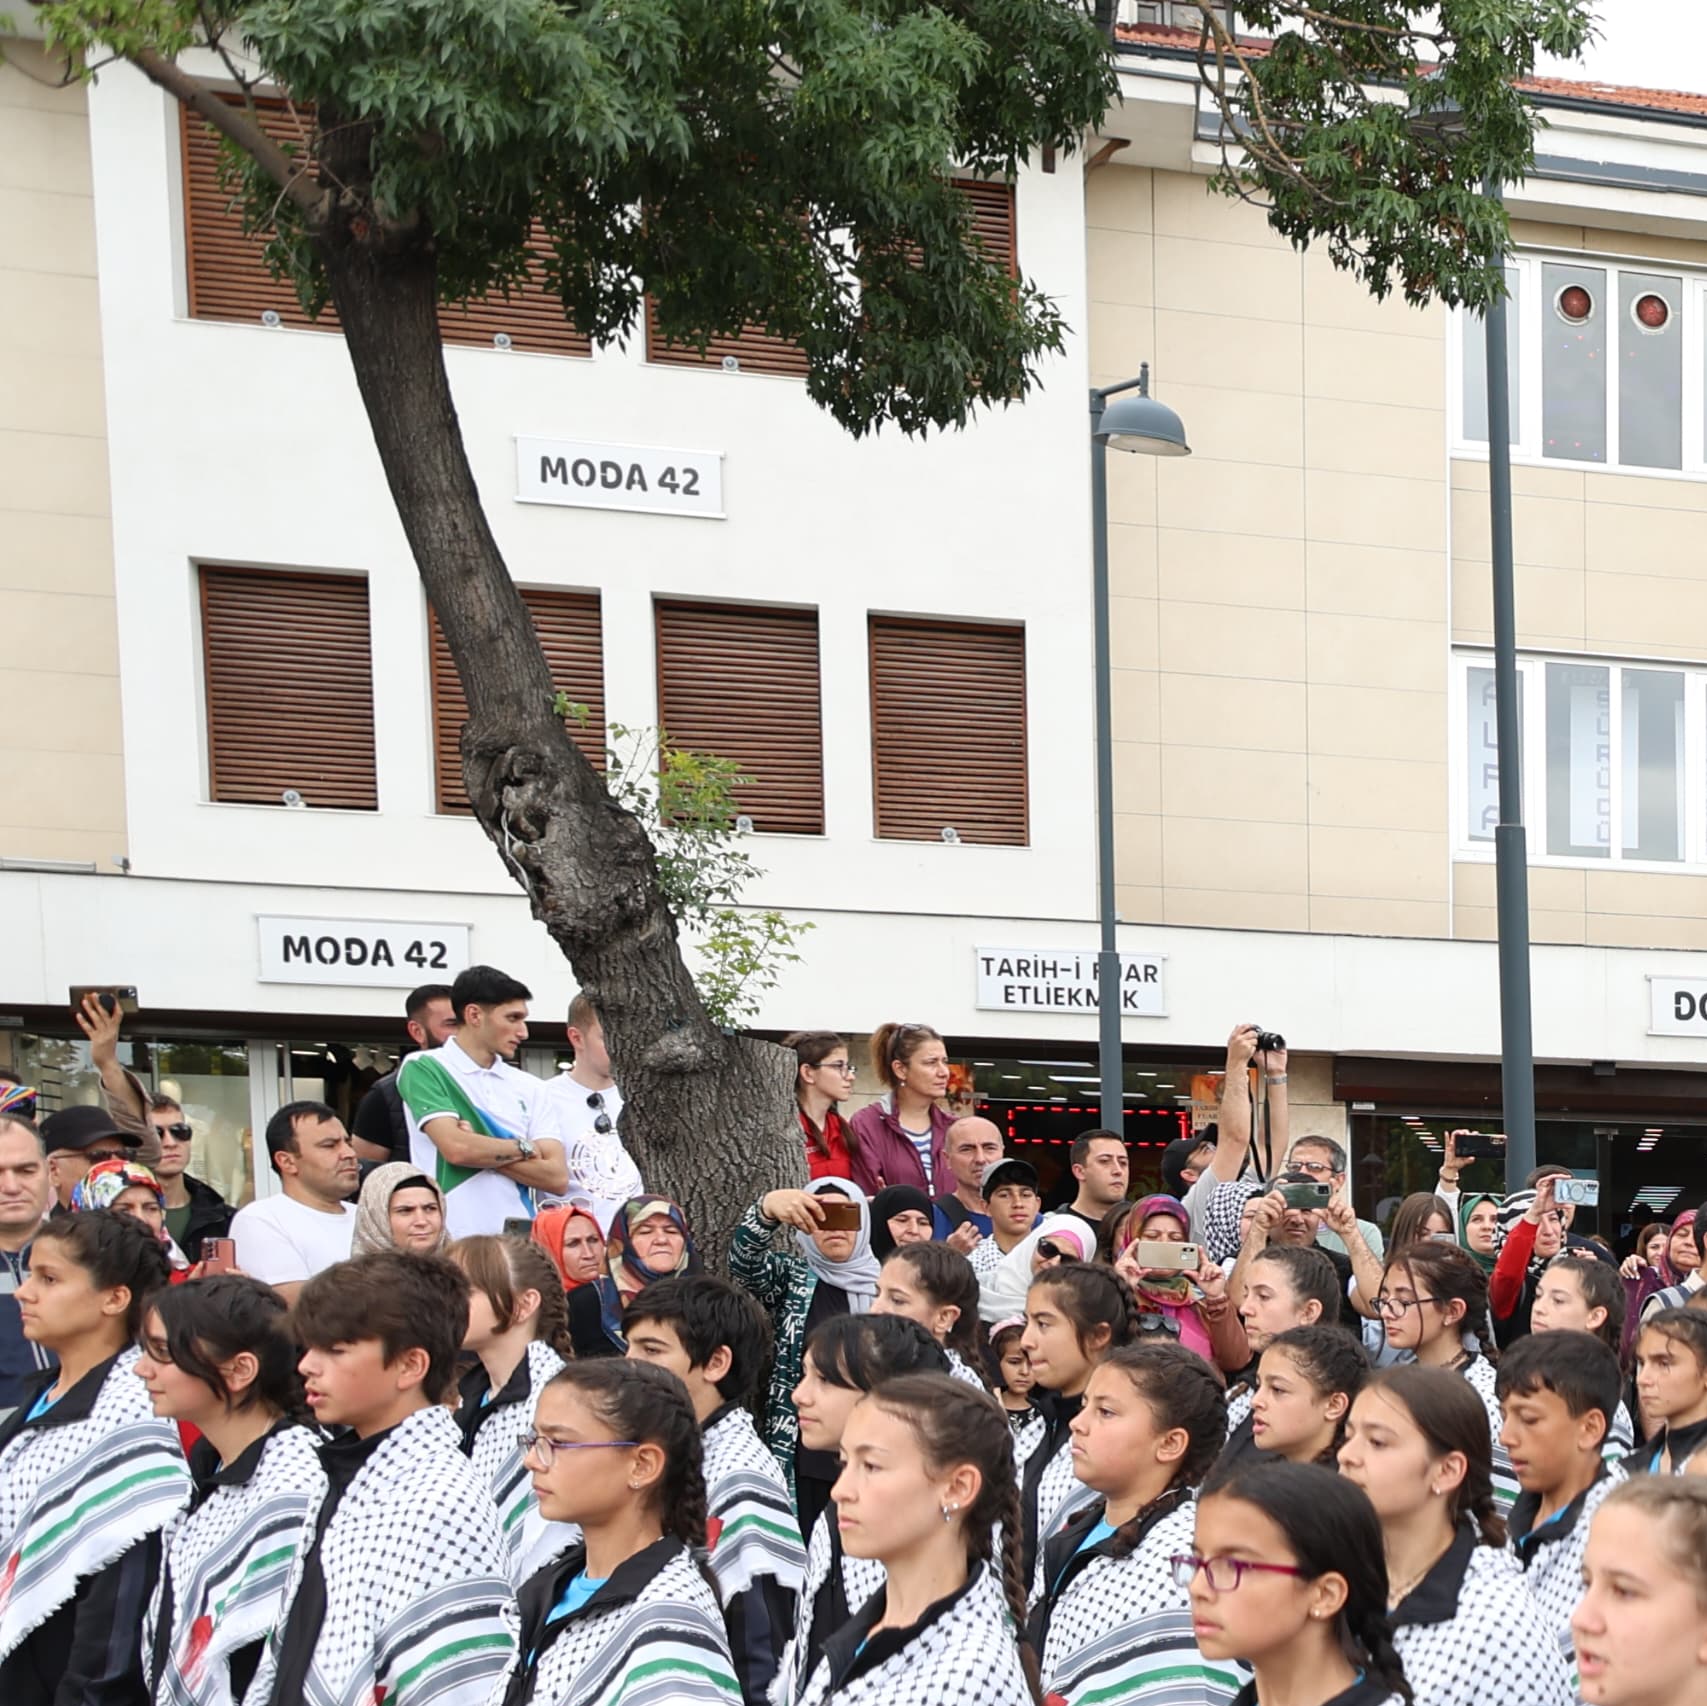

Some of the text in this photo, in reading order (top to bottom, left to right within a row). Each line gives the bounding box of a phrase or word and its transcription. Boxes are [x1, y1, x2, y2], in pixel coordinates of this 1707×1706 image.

[540, 455, 700, 496] MODA 42
[282, 934, 449, 969] MODA 42
[980, 953, 1081, 981] TARİH-İ
[1003, 981, 1139, 1009] ETLİEKMK
